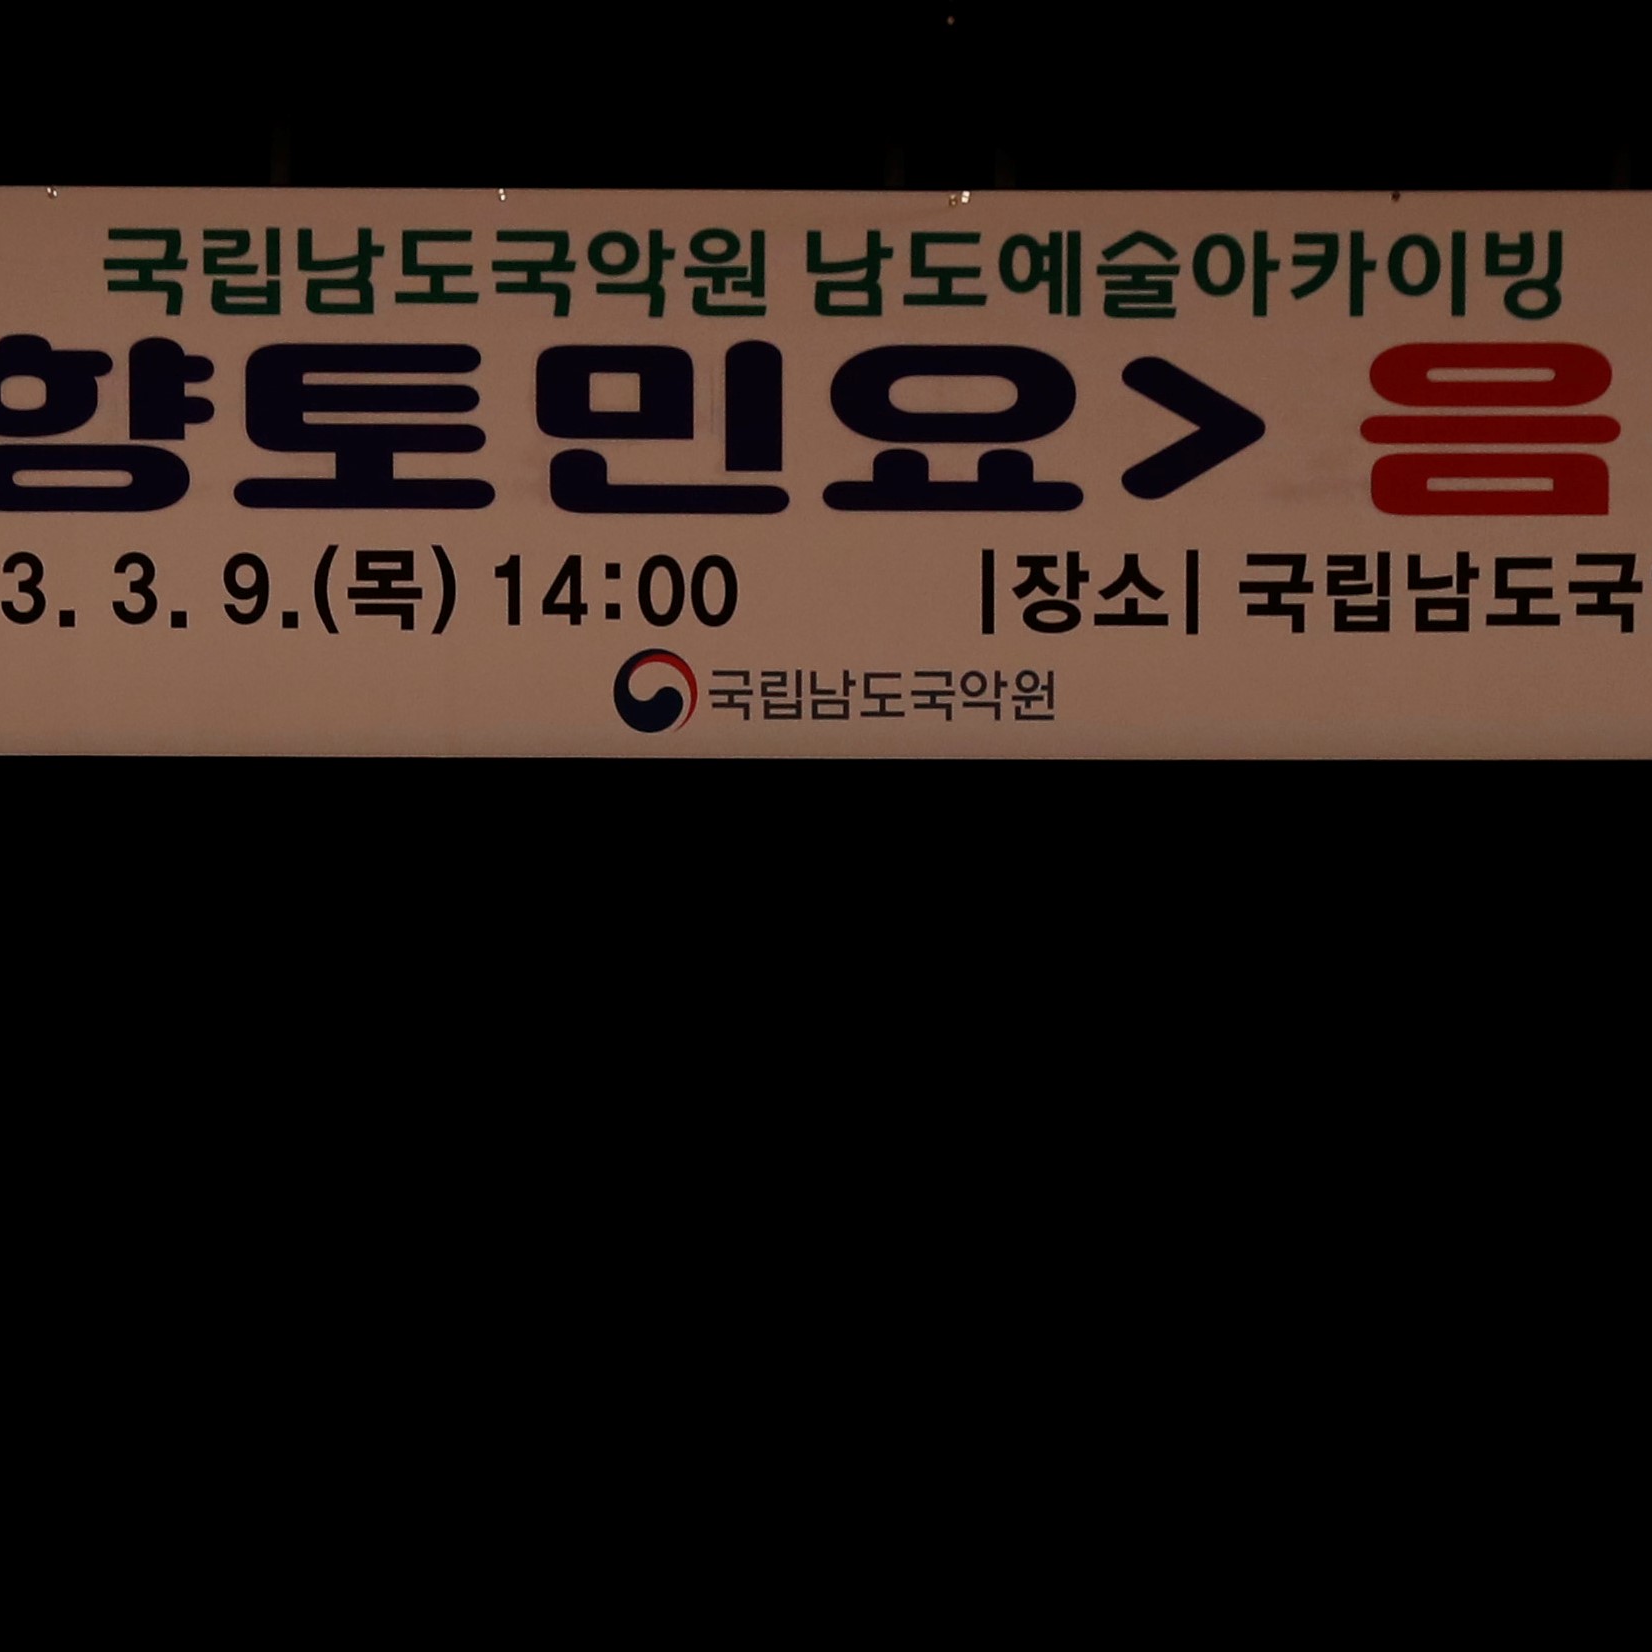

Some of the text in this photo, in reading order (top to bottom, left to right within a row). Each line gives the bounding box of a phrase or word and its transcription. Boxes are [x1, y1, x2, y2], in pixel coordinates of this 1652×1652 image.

[103, 227, 1563, 321] 국립남도국악원 남도예술아카이빙
[112, 551, 187, 628] 3.
[223, 544, 456, 635] 9.(목)
[495, 554, 738, 627] 14:00
[709, 669, 1054, 721] 국립남도국악원
